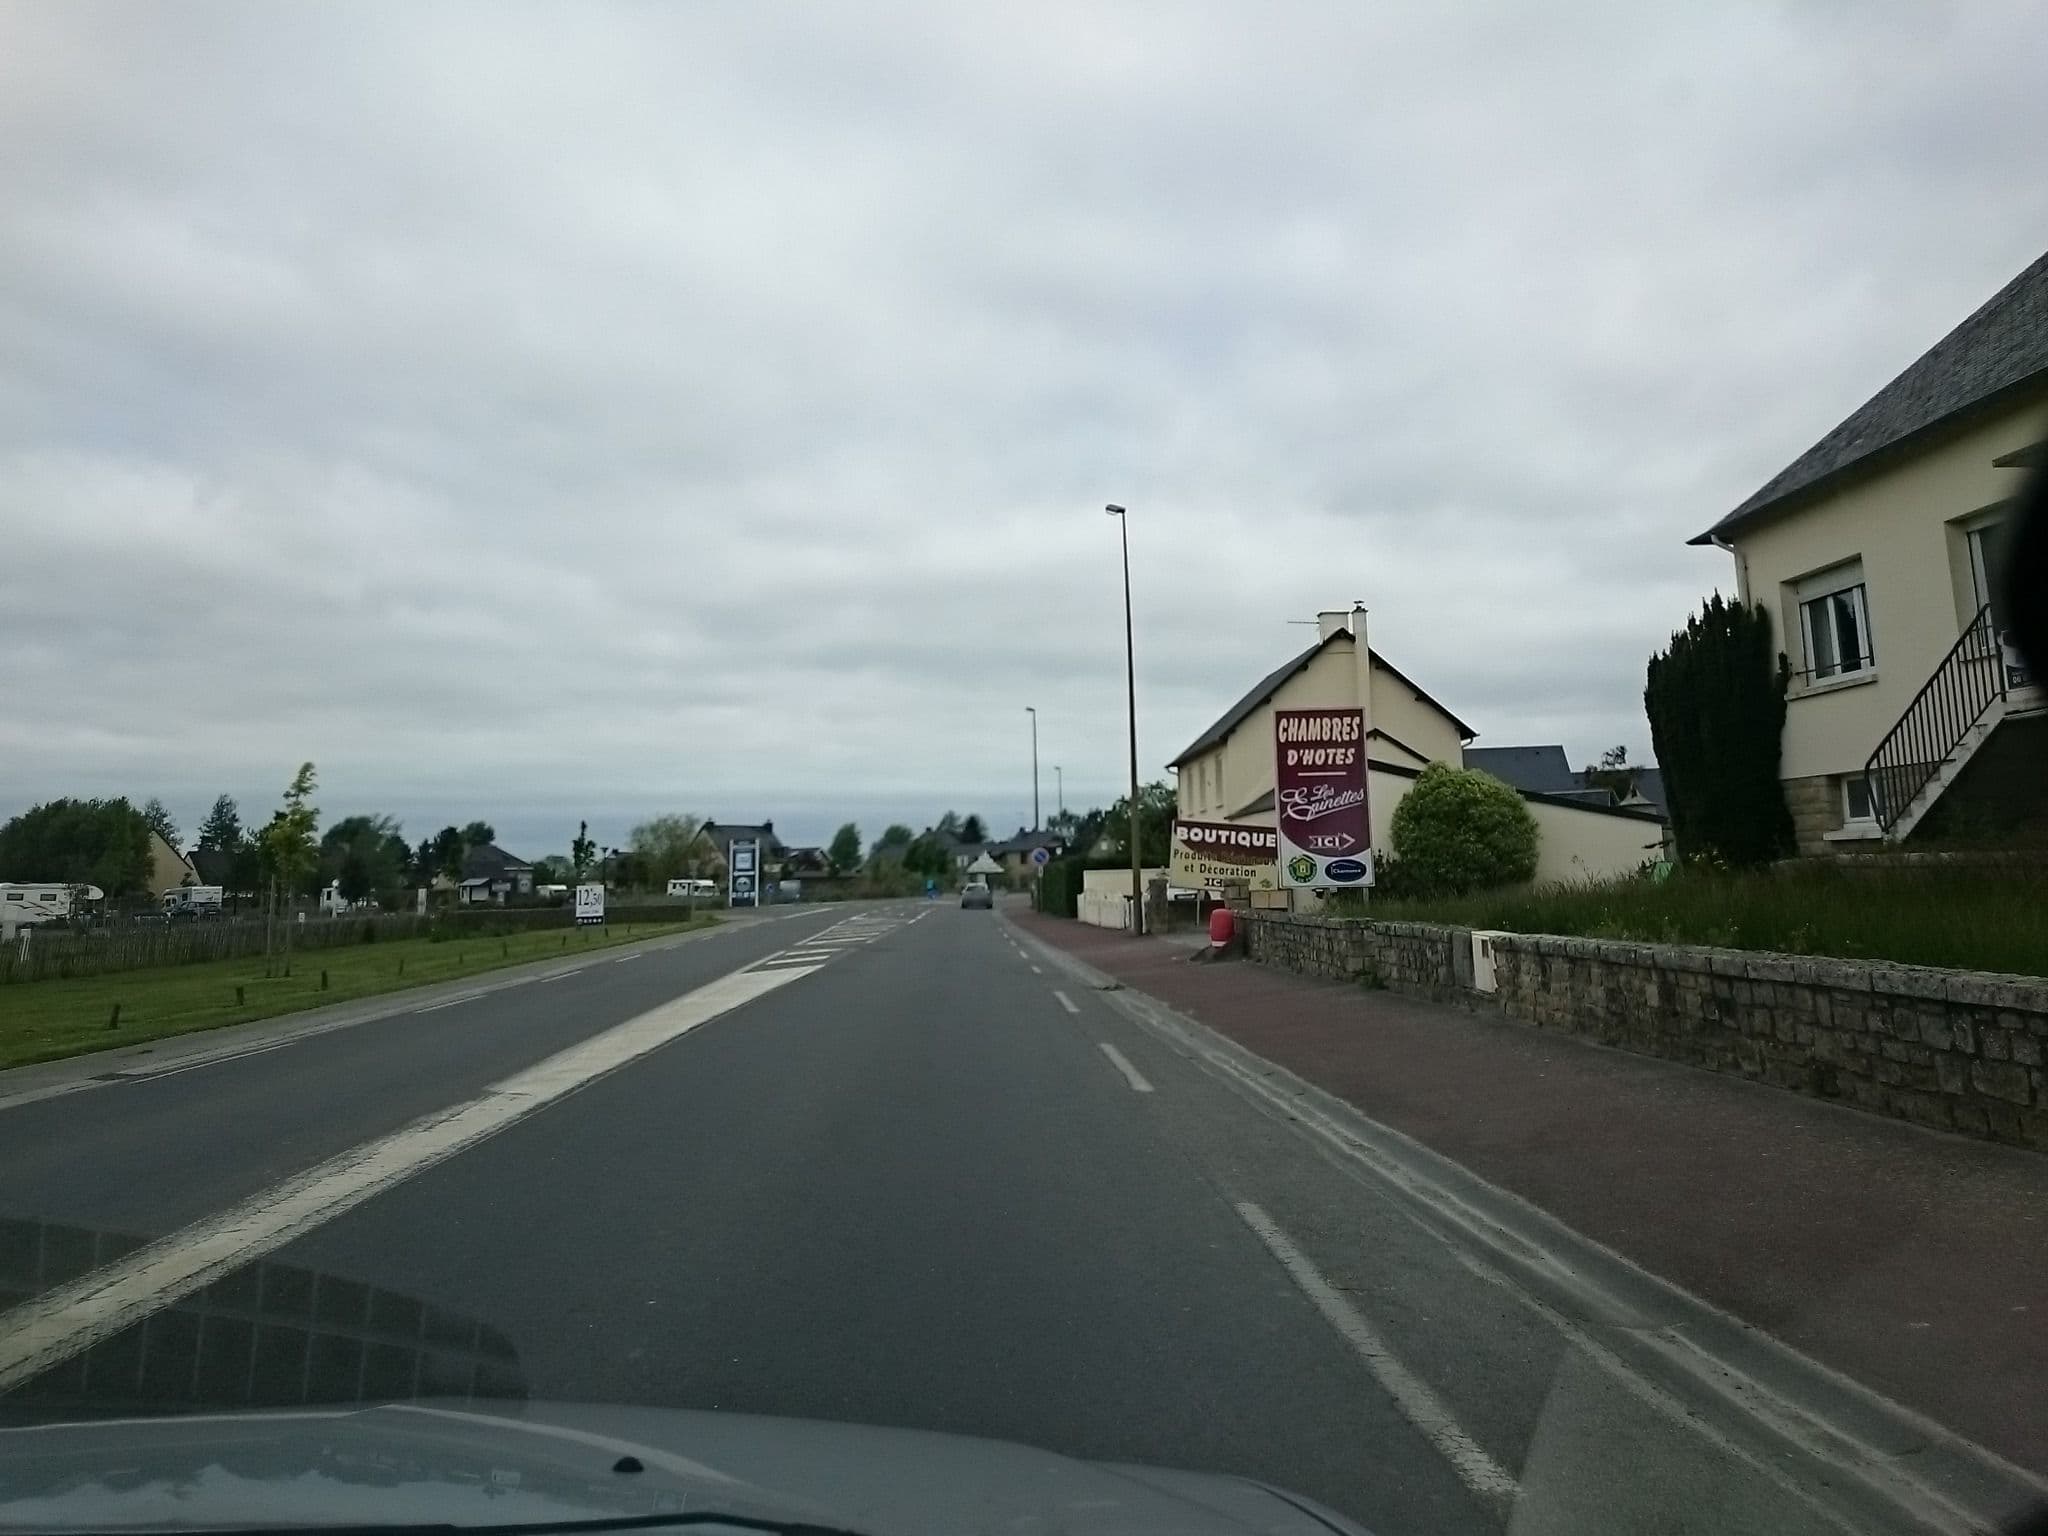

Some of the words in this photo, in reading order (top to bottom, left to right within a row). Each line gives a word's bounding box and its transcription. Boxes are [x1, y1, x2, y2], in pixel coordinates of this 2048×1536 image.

[1278, 716, 1361, 743] CHAMBRES
[1286, 748, 1355, 766] D'HOTES
[1311, 783, 1335, 801] Les
[1176, 826, 1276, 848] BOUTIQUE
[1317, 836, 1340, 847] ICI
[1184, 863, 1194, 873] et
[1199, 863, 1257, 878] Décoration
